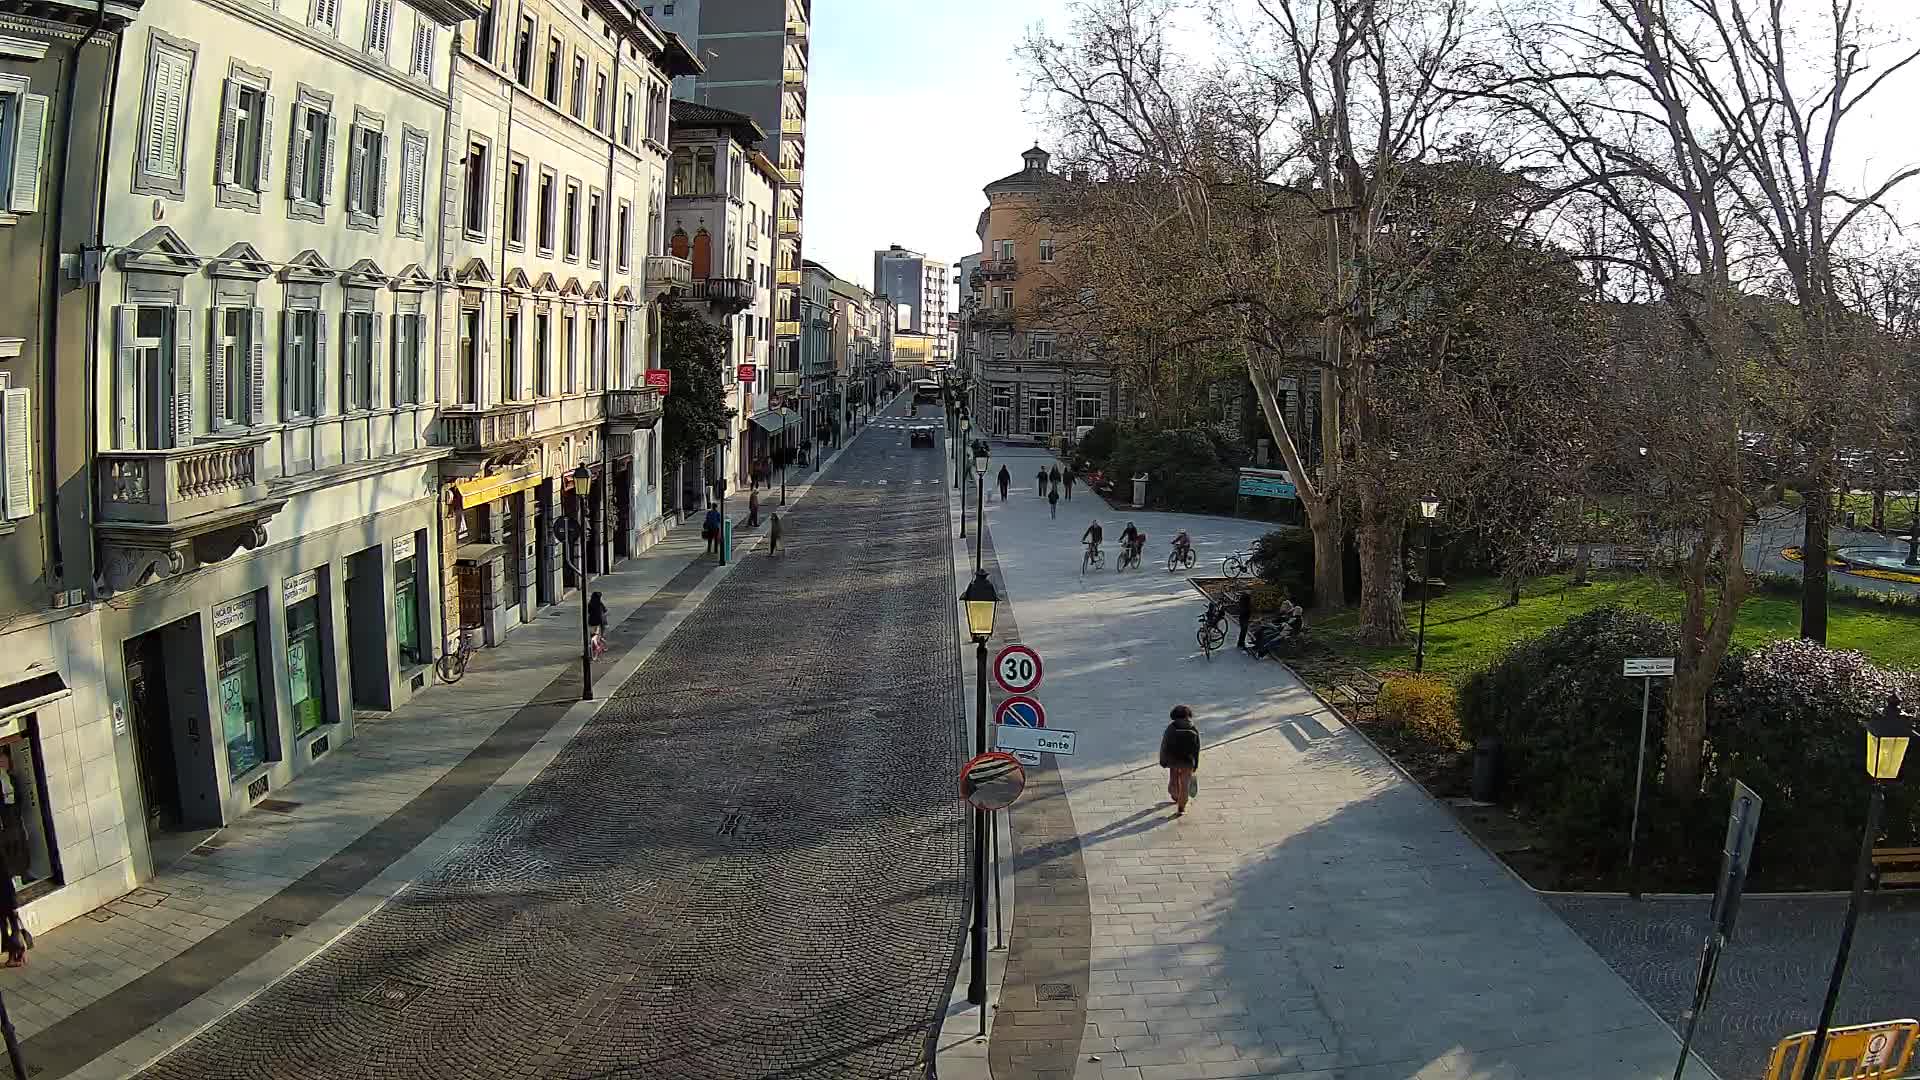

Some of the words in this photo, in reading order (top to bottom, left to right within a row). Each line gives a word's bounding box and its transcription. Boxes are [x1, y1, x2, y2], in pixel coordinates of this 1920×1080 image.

[289, 646, 304, 670] 130
[1004, 658, 1033, 680] 30
[222, 678, 240, 701] 130
[1038, 738, 1070, 750] Dante
